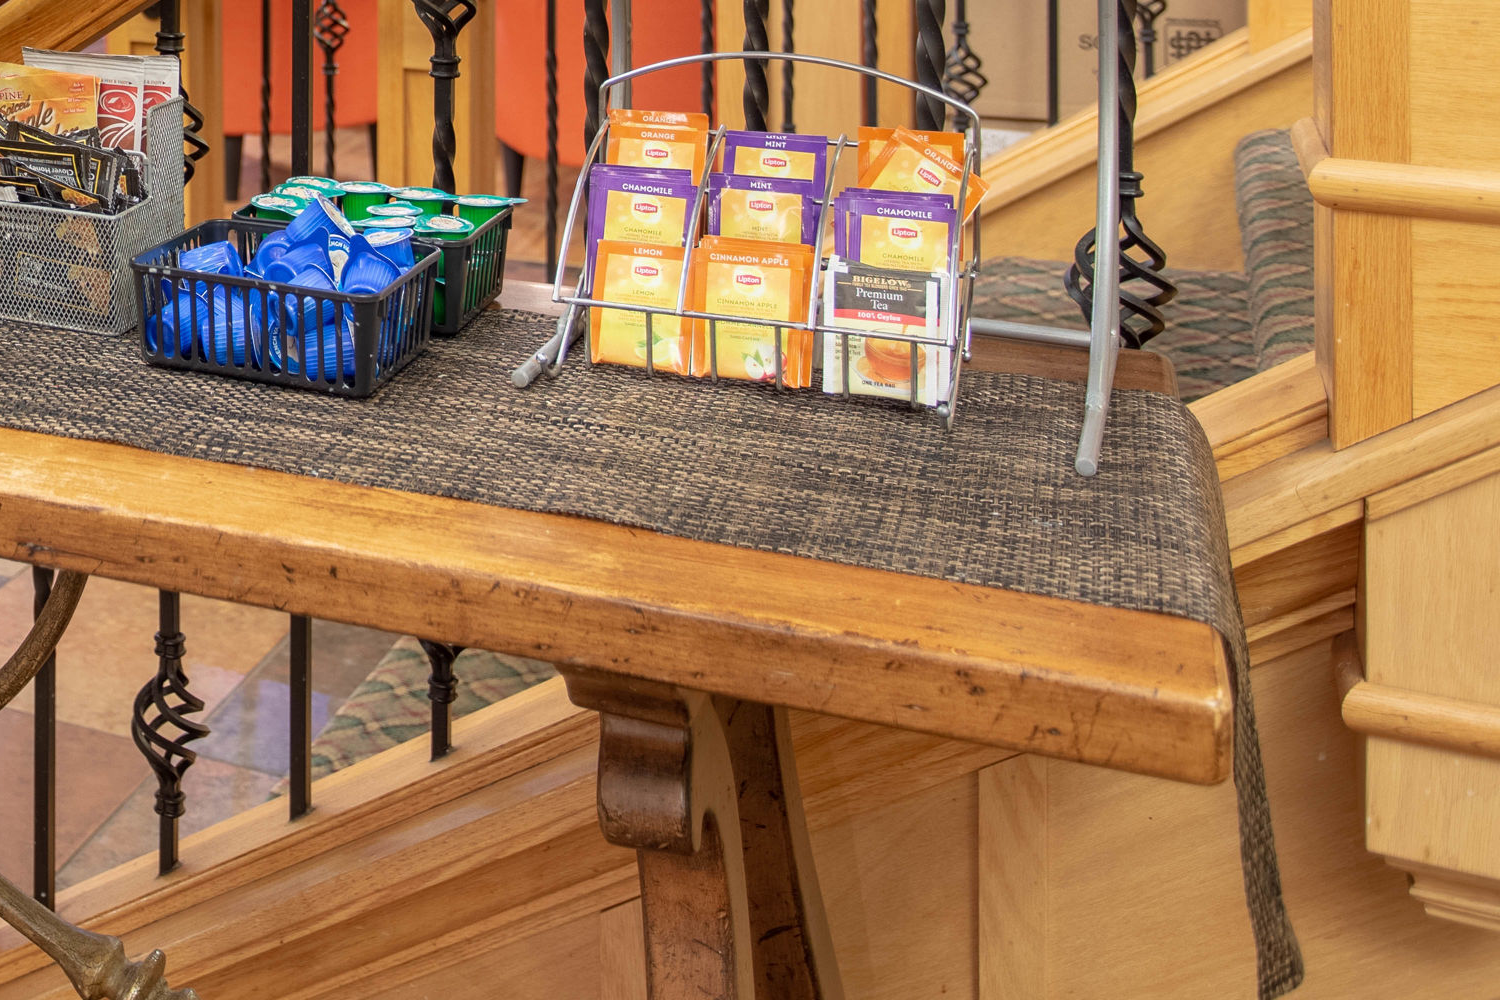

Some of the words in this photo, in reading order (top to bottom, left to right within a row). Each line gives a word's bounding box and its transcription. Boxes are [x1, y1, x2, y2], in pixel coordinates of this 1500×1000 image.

[0, 94, 31, 116] Spiced
[640, 131, 675, 140] ORANGE
[765, 140, 787, 148] MINT
[646, 149, 667, 157] Lipton
[764, 158, 786, 166] Lipton
[924, 148, 957, 173] ORANGE
[29, 163, 51, 174] Honey
[51, 167, 74, 176] Clover
[918, 168, 940, 185] Lipton
[622, 183, 673, 195] CHAMOMILE
[750, 181, 773, 190] MINT
[635, 204, 657, 212] Lipton
[750, 201, 772, 210] Lipton
[876, 207, 933, 219] CHAMOMILE
[623, 227, 662, 236] CHAMOMILE
[893, 228, 916, 237] Lipton
[633, 247, 663, 257] LEMON
[709, 252, 759, 264] CINNAMON
[761, 257, 789, 266] APPLE
[882, 252, 925, 262] CHAMOMILE
[635, 267, 657, 276] Lipton
[737, 275, 760, 284] Lipton
[852, 275, 908, 287] BIGELOW
[855, 287, 904, 301] Premium
[716, 298, 755, 306] CINNAMON
[870, 299, 889, 311] Tea
[857, 311, 876, 319] 100%
[876, 313, 901, 322] Ceylon
